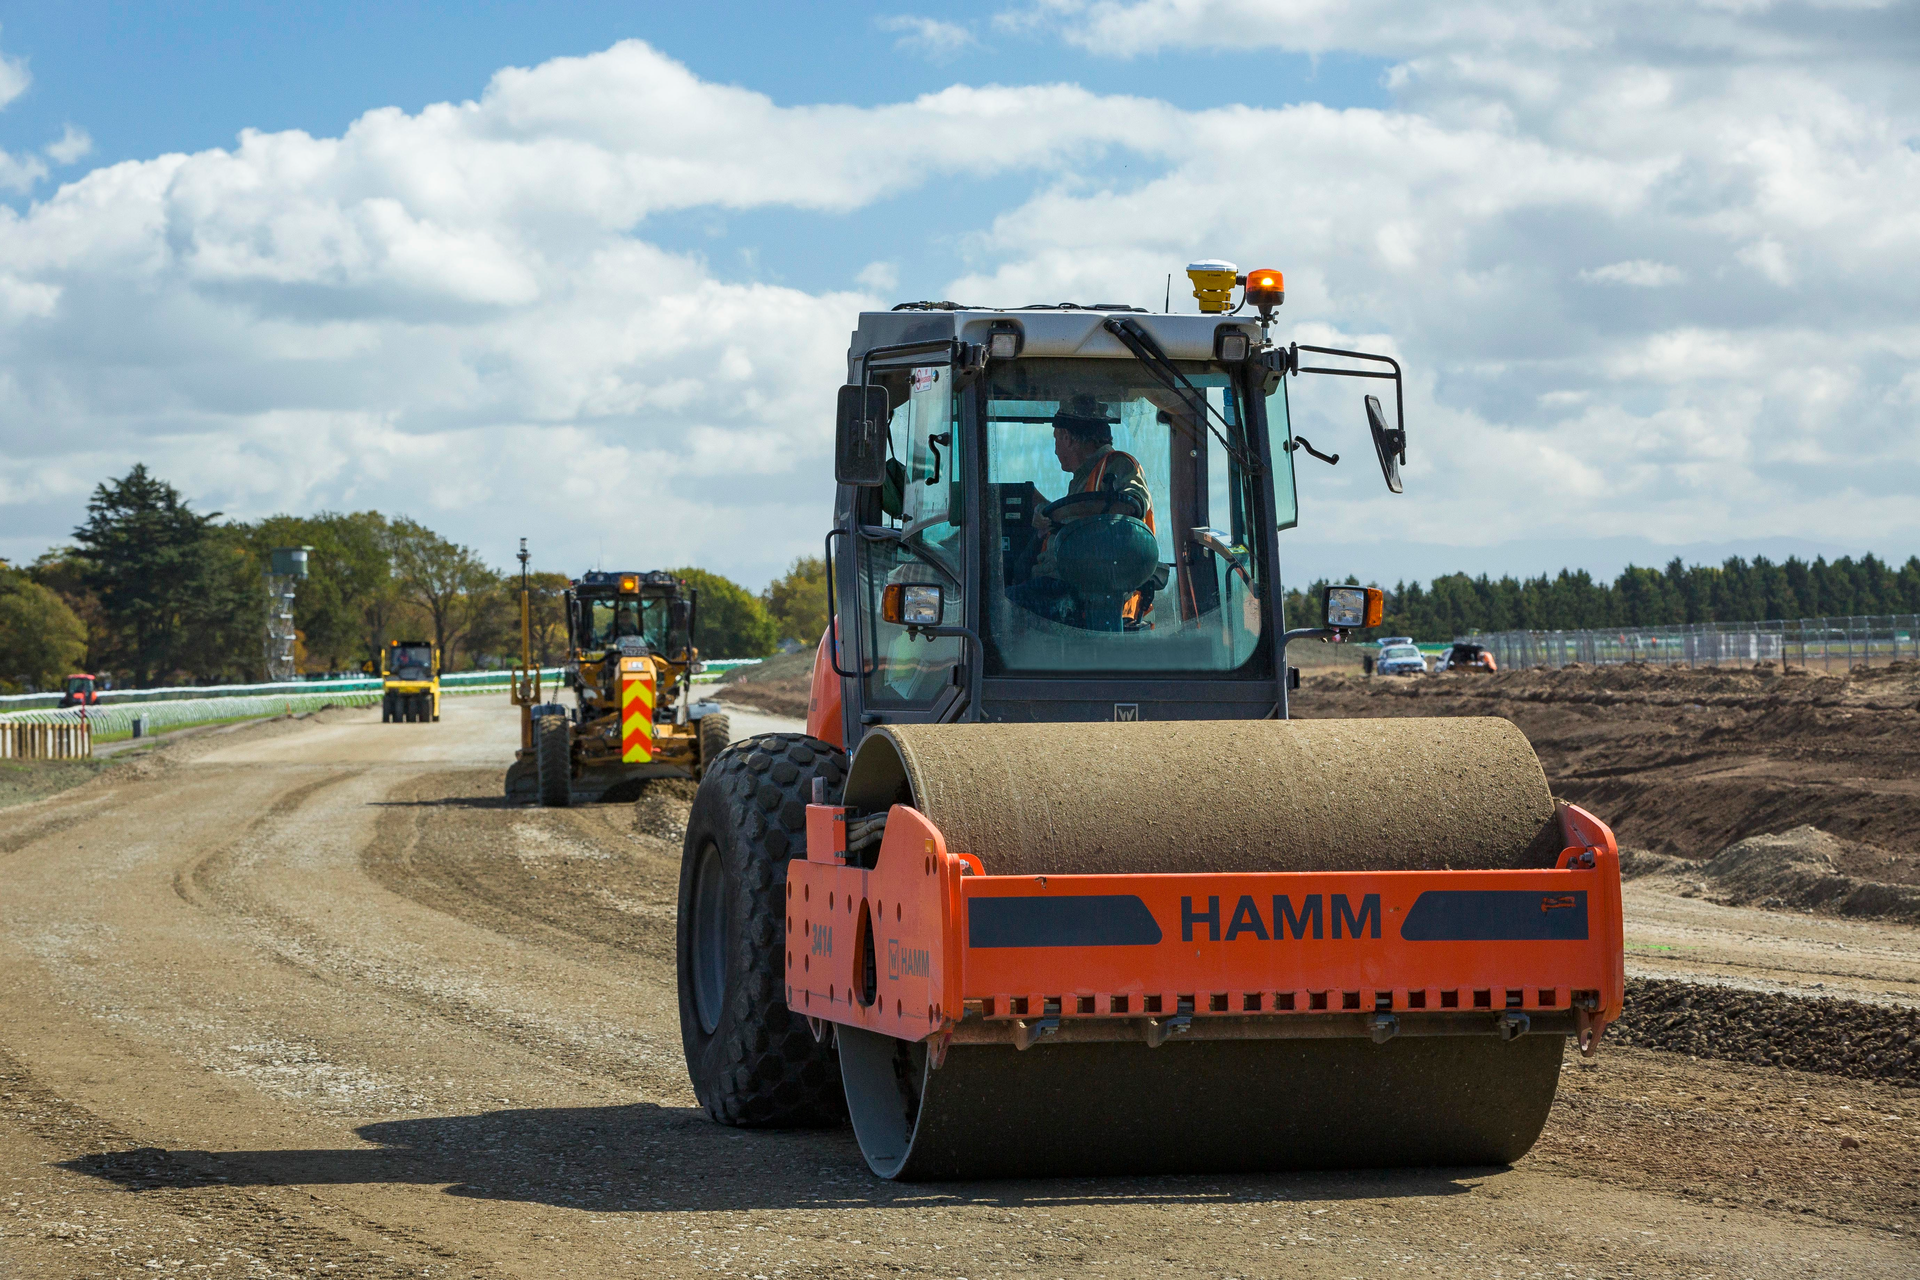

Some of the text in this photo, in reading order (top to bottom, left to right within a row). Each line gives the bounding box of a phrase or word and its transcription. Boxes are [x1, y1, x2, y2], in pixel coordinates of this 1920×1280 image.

[1180, 893, 1382, 942] HAMM
[811, 923, 833, 958] 3414
[901, 947, 930, 978] HAMM
